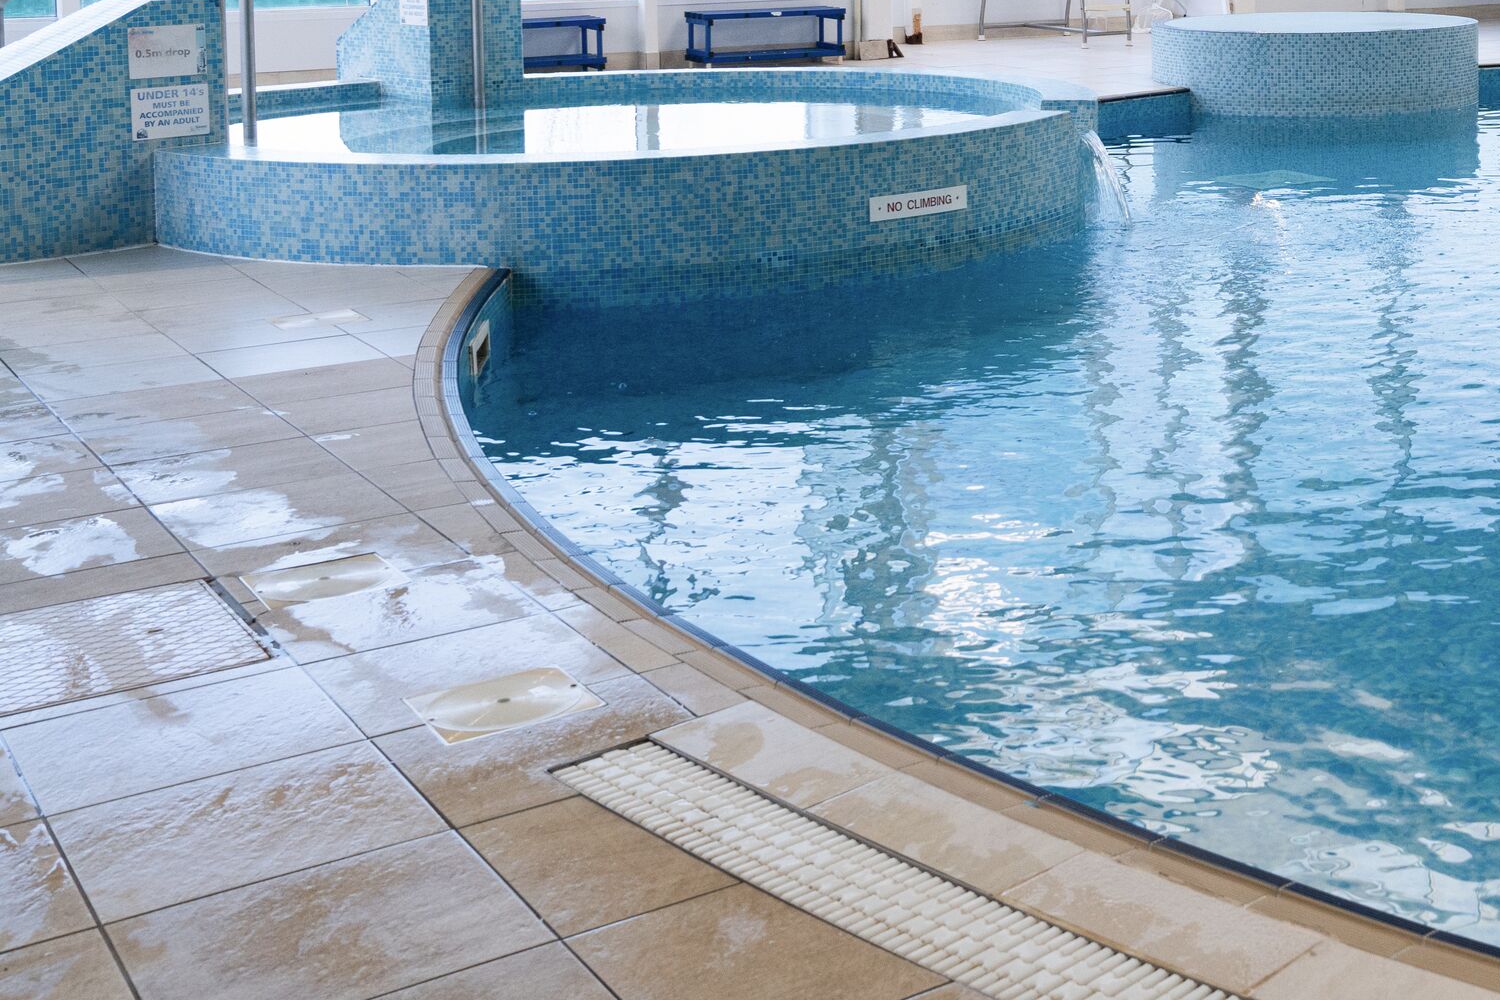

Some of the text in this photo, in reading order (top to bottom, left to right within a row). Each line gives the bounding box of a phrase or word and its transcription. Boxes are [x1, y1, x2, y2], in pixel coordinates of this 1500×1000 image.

[135, 48, 191, 59] 0.5m drop
[137, 87, 205, 101] UNDER 14's
[152, 99, 191, 110] MUST BE
[139, 107, 204, 120] ACCOMPANIED
[144, 116, 200, 128] BY AN ADULT
[886, 194, 952, 213] NO CLIMBING
